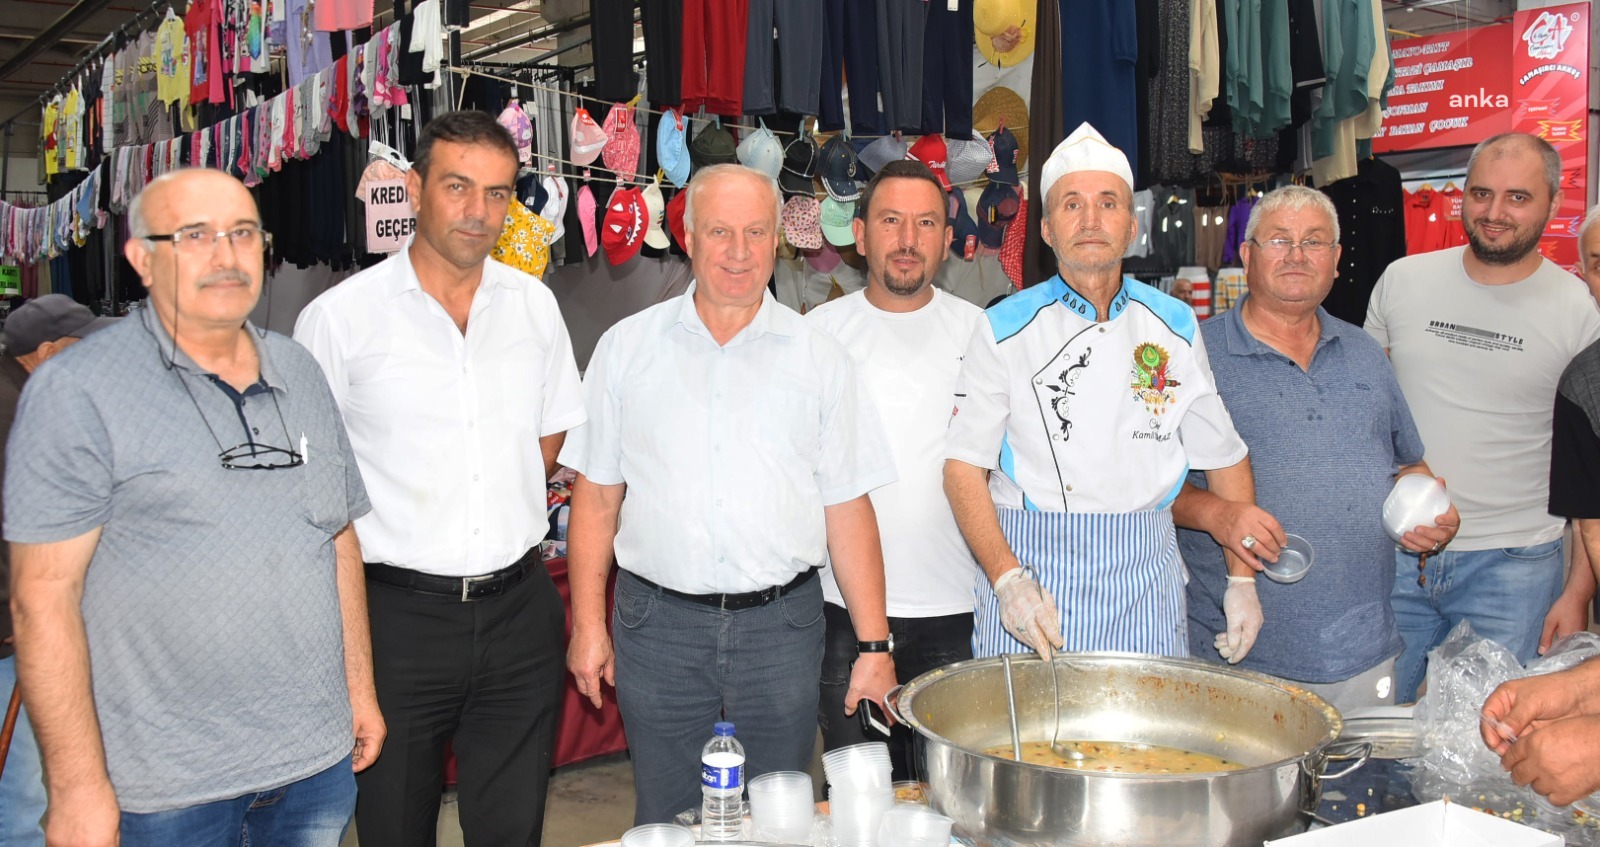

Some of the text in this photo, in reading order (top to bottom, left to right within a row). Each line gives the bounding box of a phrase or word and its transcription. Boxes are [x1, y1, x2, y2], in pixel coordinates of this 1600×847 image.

[1394, 57, 1474, 78] NTAZİ ÇAMAŞIR
[1382, 102, 1428, 119] ŞOFMAN
[1429, 117, 1469, 133] ÇOCUK
[1429, 320, 1456, 330] URBAN
[1495, 333, 1524, 345] STYLE
